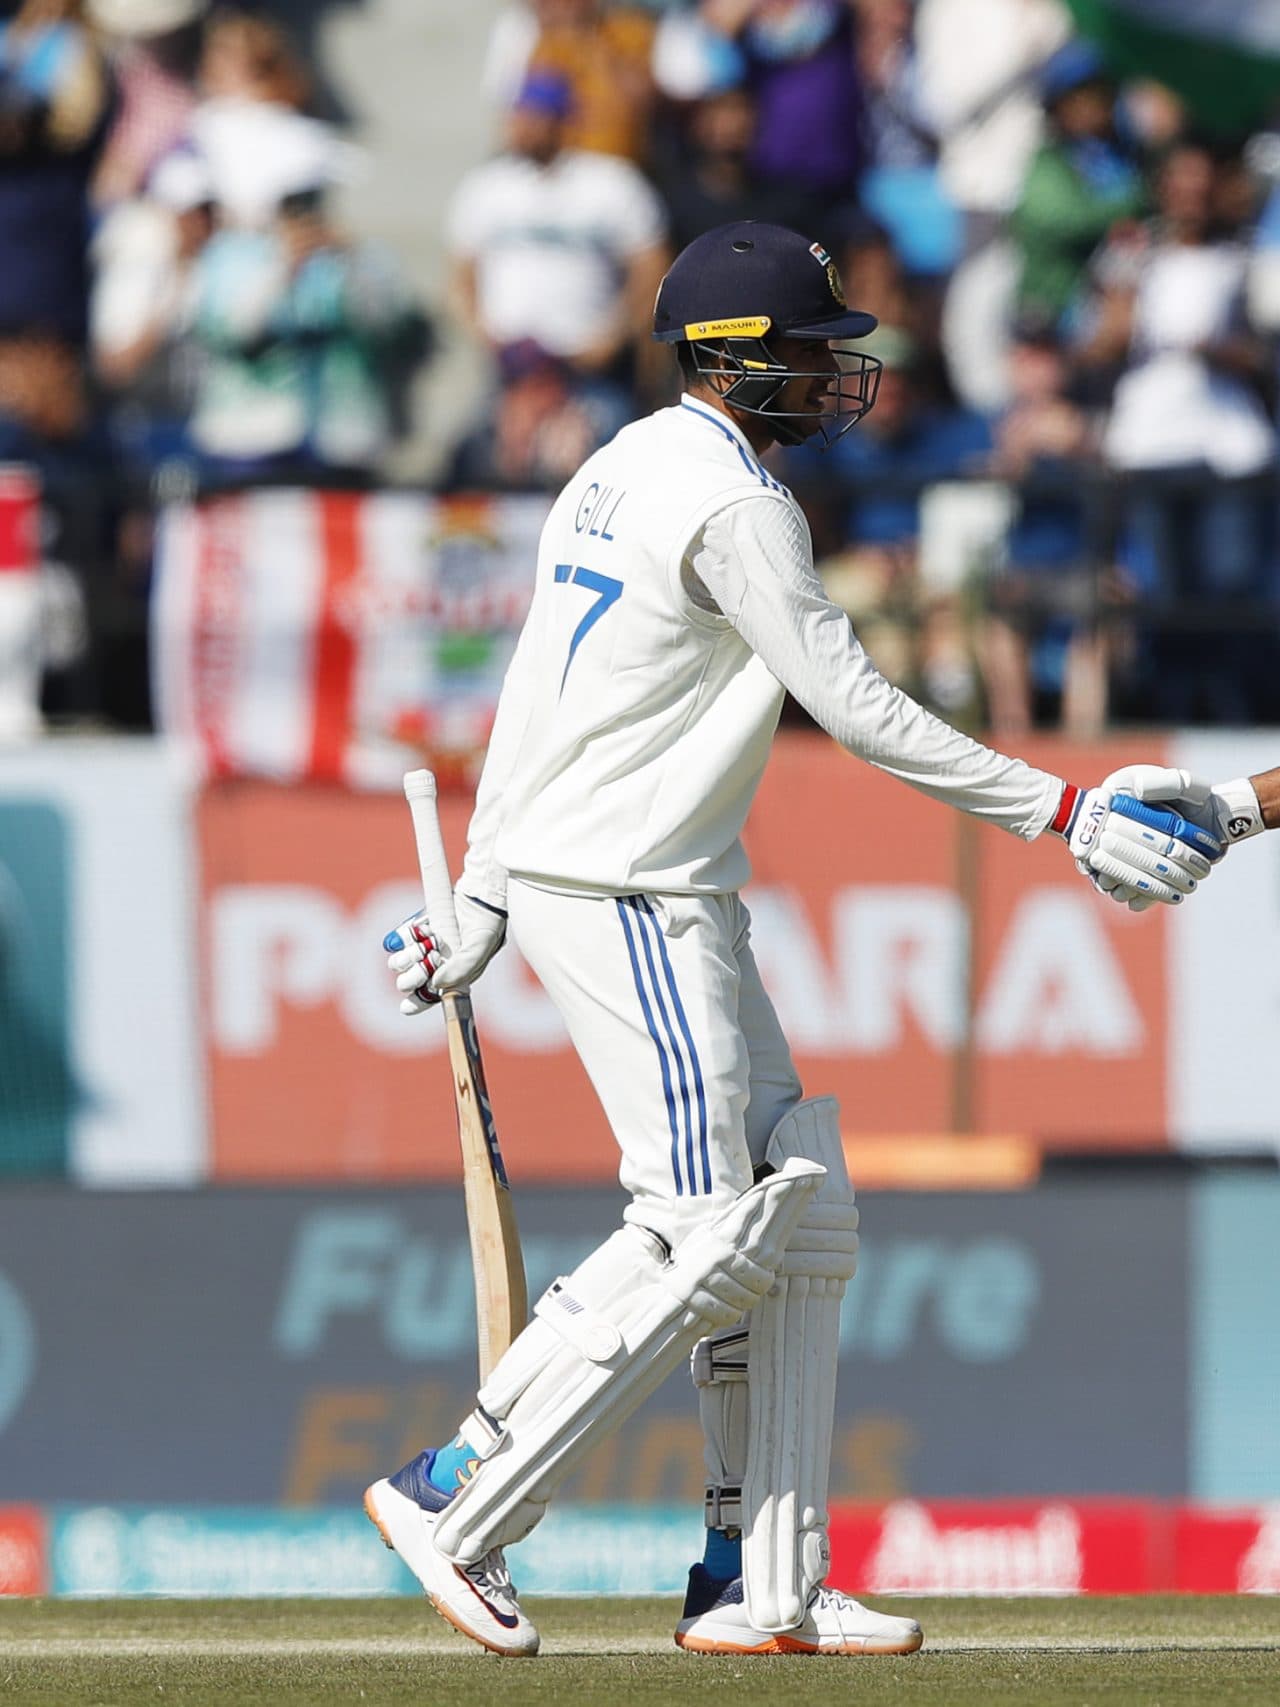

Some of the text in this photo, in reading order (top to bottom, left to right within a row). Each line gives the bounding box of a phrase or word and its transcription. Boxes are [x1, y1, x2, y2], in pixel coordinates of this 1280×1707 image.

[711, 321, 757, 332] MASURI
[575, 482, 626, 541] GILL
[553, 564, 624, 705] 7
[1079, 800, 1107, 845] CEAT
